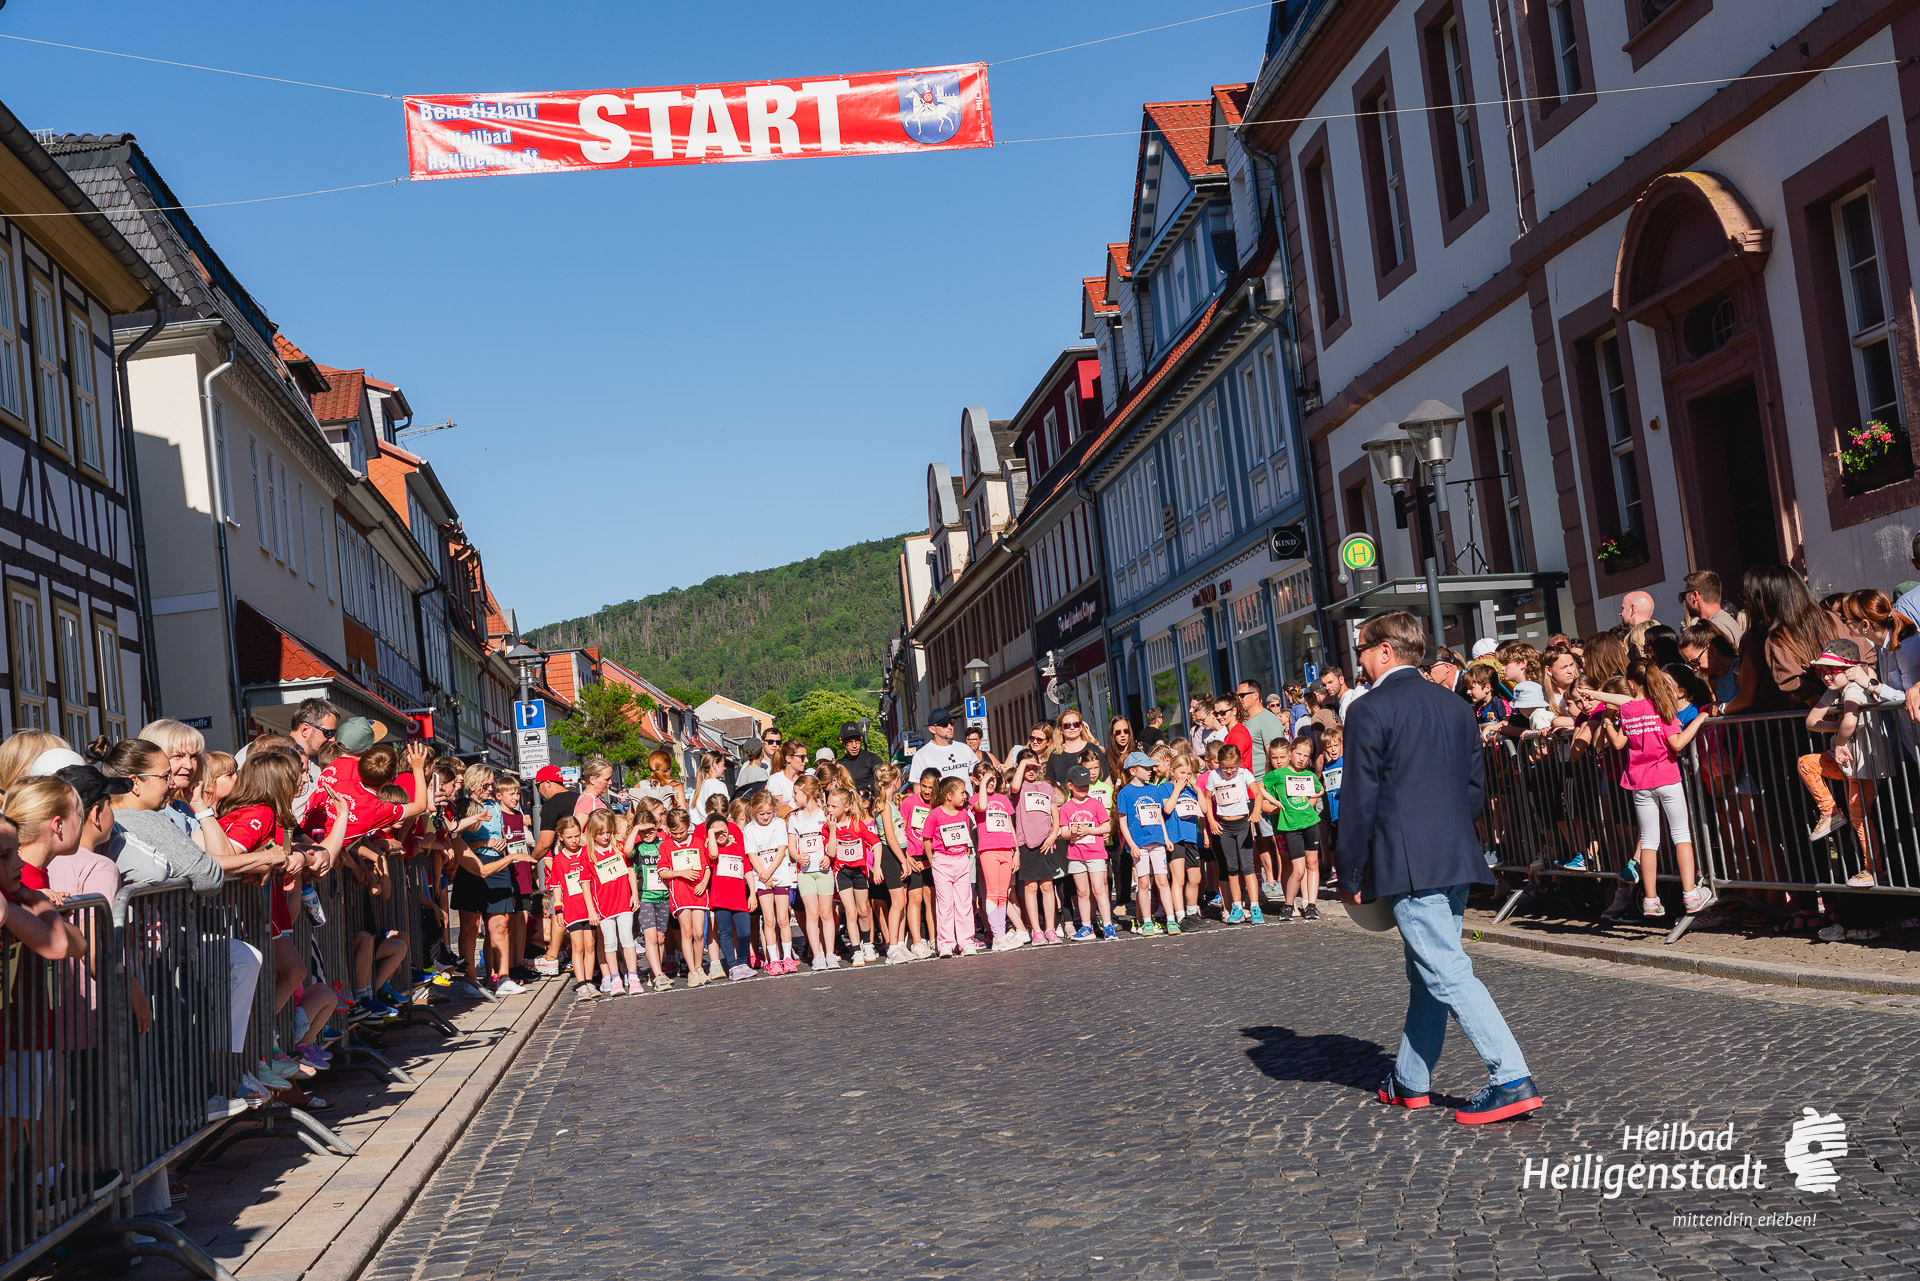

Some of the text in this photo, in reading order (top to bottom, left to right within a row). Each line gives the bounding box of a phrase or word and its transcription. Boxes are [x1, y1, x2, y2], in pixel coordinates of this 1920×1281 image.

[419, 101, 537, 121] Benefizlauf
[578, 79, 851, 164] START
[449, 129, 512, 145] Heilbad
[427, 149, 538, 170] Heiligenstadt
[1275, 539, 1297, 547] KIND
[1352, 545, 1367, 563] H
[970, 700, 982, 716] P
[522, 704, 538, 726] P
[942, 763, 968, 771] CUBE
[1329, 777, 1337, 785] 21
[1294, 783, 1306, 791] 26
[1221, 791, 1230, 799] 11
[1034, 798, 1045, 806] 44
[1148, 811, 1158, 819] 30
[995, 819, 1005, 827] 23
[950, 832, 961, 841] 59
[806, 838, 817, 847] 57
[844, 848, 855, 856] 60
[764, 856, 774, 864] 14
[607, 865, 618, 875] 11
[729, 863, 739, 872] 16
